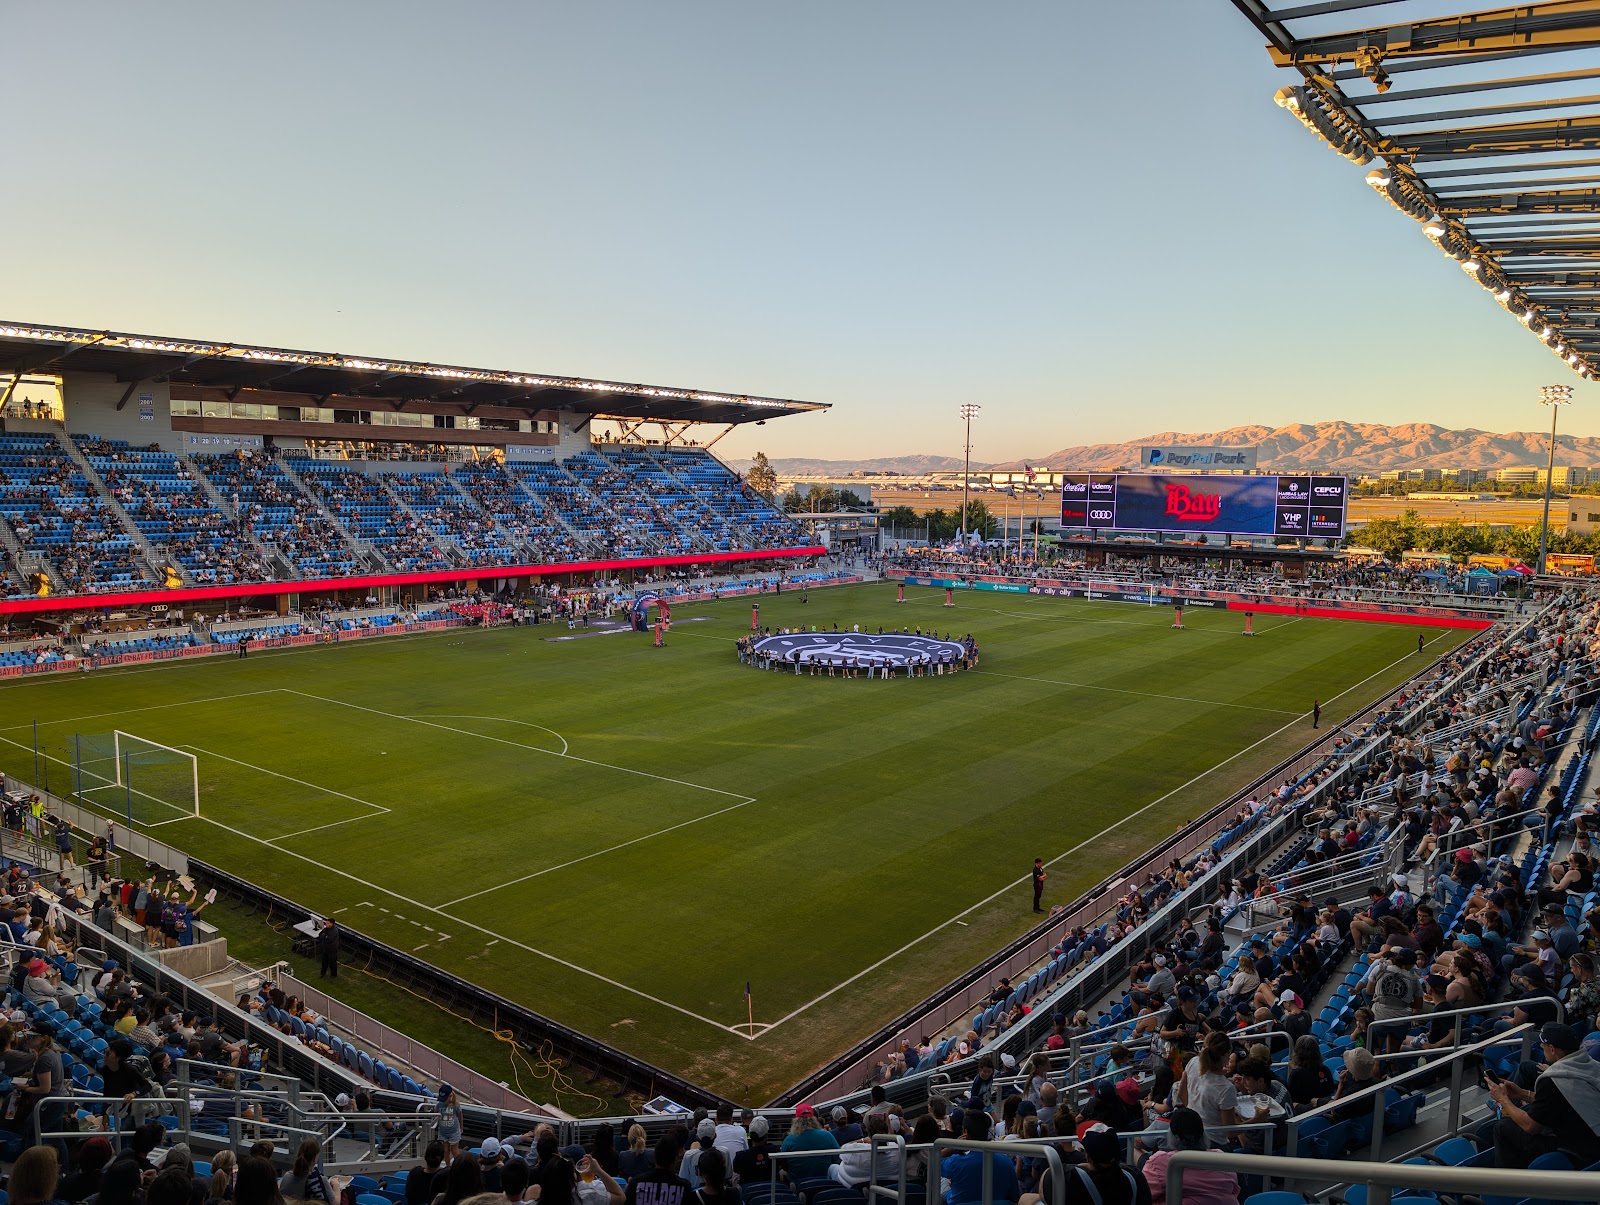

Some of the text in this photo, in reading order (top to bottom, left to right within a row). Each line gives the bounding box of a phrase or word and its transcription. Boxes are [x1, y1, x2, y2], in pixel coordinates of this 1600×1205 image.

[1167, 452, 1247, 465] PayPal Park
[1313, 486, 1341, 494] CEFCU
[1164, 482, 1220, 522] Bay
[1282, 513, 1302, 521] VHP
[1029, 587, 1041, 595] ally
[1044, 588, 1056, 596] ally
[1059, 588, 1071, 597] ally
[1189, 599, 1215, 607] Nationwide
[132, 652, 144, 662] BAY
[33, 662, 56, 673] BAY FC
[17, 883, 27, 893] 22
[635, 1181, 685, 1205] GOLDEN
